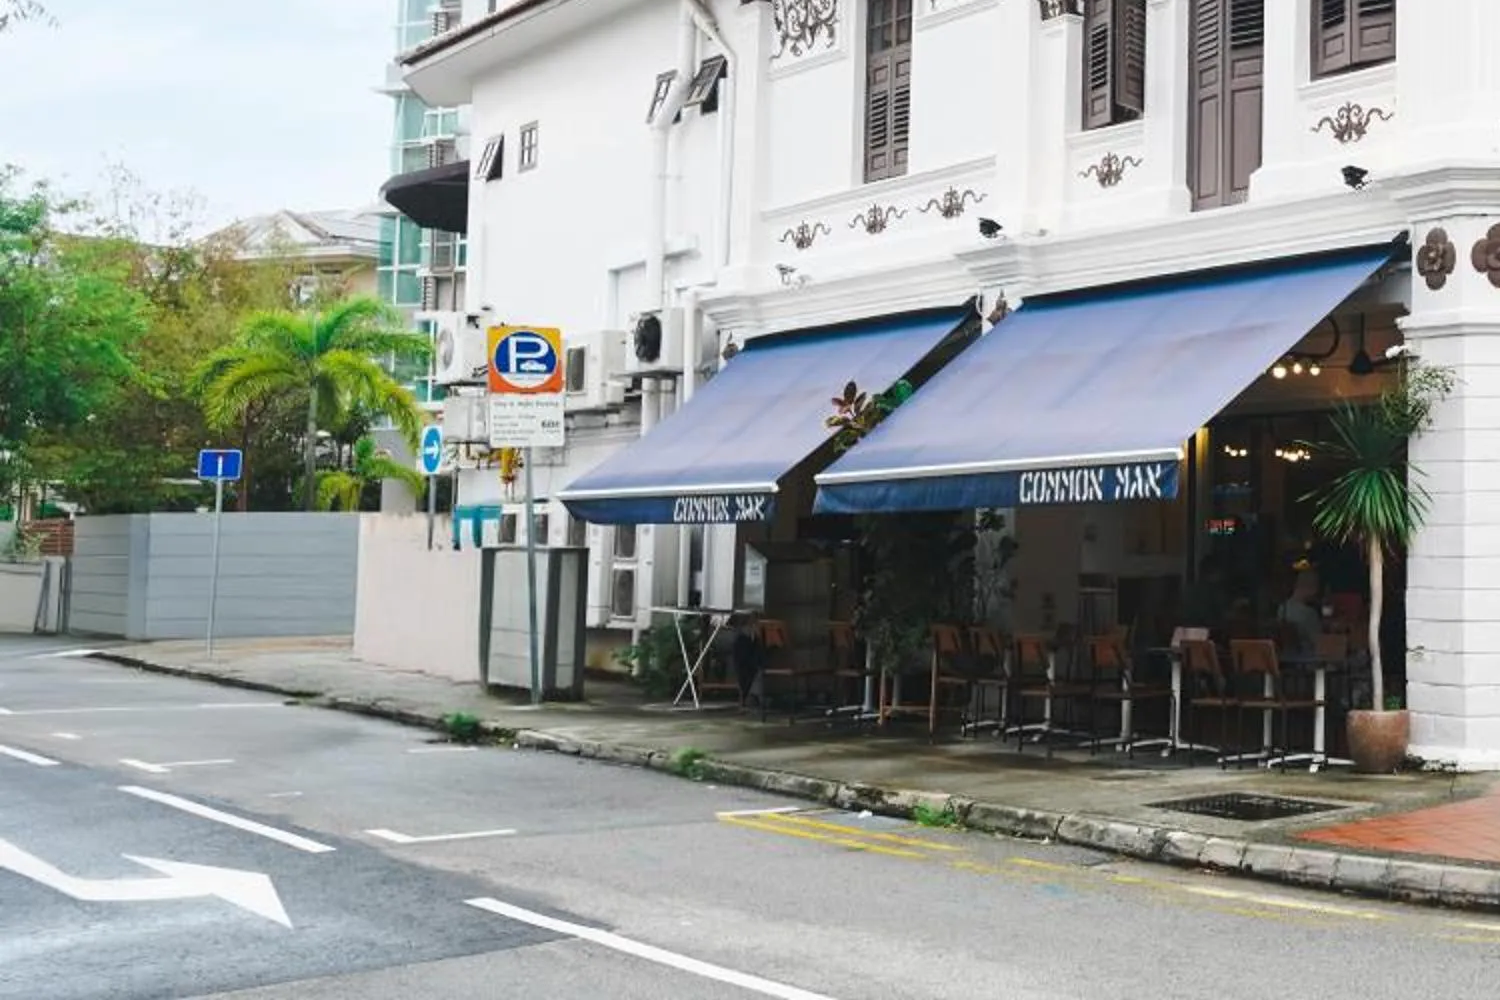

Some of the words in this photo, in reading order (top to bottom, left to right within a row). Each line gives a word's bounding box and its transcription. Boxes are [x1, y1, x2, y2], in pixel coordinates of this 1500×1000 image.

[508, 335, 549, 373] P
[1019, 467, 1104, 504] COMMON
[1115, 463, 1162, 499] MAN
